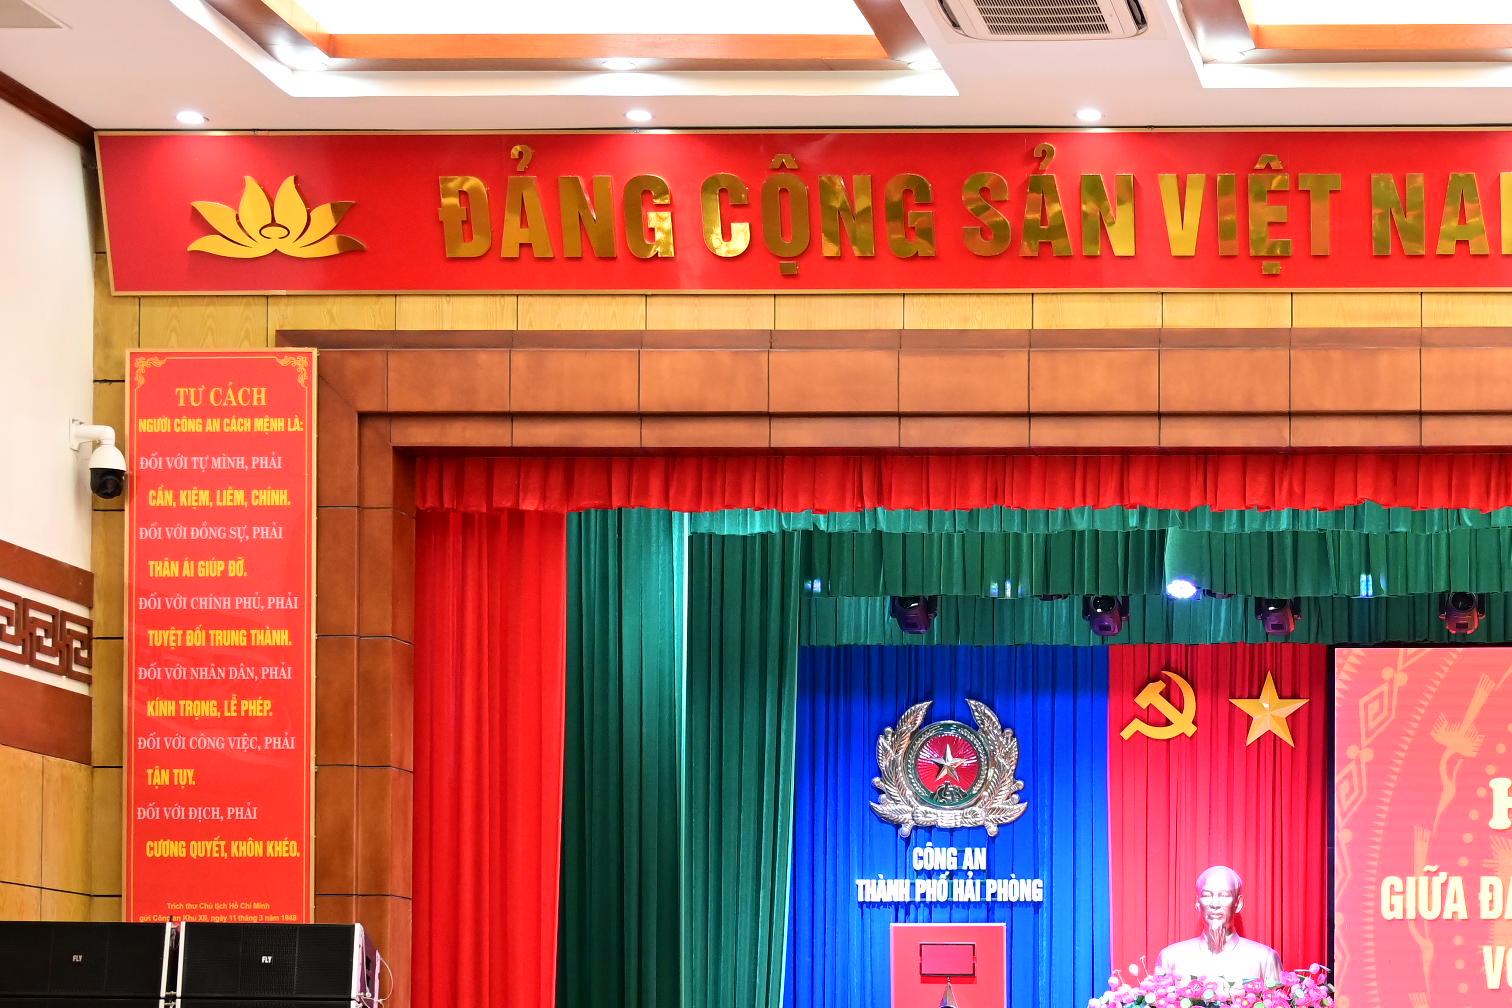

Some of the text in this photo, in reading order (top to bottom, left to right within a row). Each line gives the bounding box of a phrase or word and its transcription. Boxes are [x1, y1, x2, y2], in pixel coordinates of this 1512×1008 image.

[438, 145, 675, 258] ĐẢNG
[702, 154, 936, 275] CỘNG
[961, 142, 1137, 258] SẢN
[1159, 154, 1342, 274] VIỆT
[176, 382, 266, 406] TƯ CÁCH
[139, 416, 303, 434] NGƯỜI CÔNG AN CÁCH MỆNH LÀ:
[140, 452, 282, 472] ĐỐI VỚI TỰ MÌNH, PHẢI
[149, 485, 290, 509] CẦN, KIỆM, LIÊM, CHÍNH.
[140, 521, 283, 542] ĐỐI VỚI ĐỒNG SỰ, PHẢI
[149, 557, 247, 577] THÂN ÁI GIÚP ĐỠ.
[148, 625, 291, 649] TUYỆT ĐỐI TRUNG THÀNH.
[147, 697, 175, 716] KÍNH
[179, 700, 220, 720] TRỌNG,
[241, 697, 272, 716] PHÉP.
[147, 766, 195, 789] TẬN TỤY.
[146, 836, 300, 858] CƯƠNG QUYẾT, KHÔN KHÉO.
[913, 842, 986, 870] CÔNG AN
[856, 869, 1044, 902] THÀNH PHỐ HẢI PHÒNG
[1381, 865, 1467, 920] GIỮA
